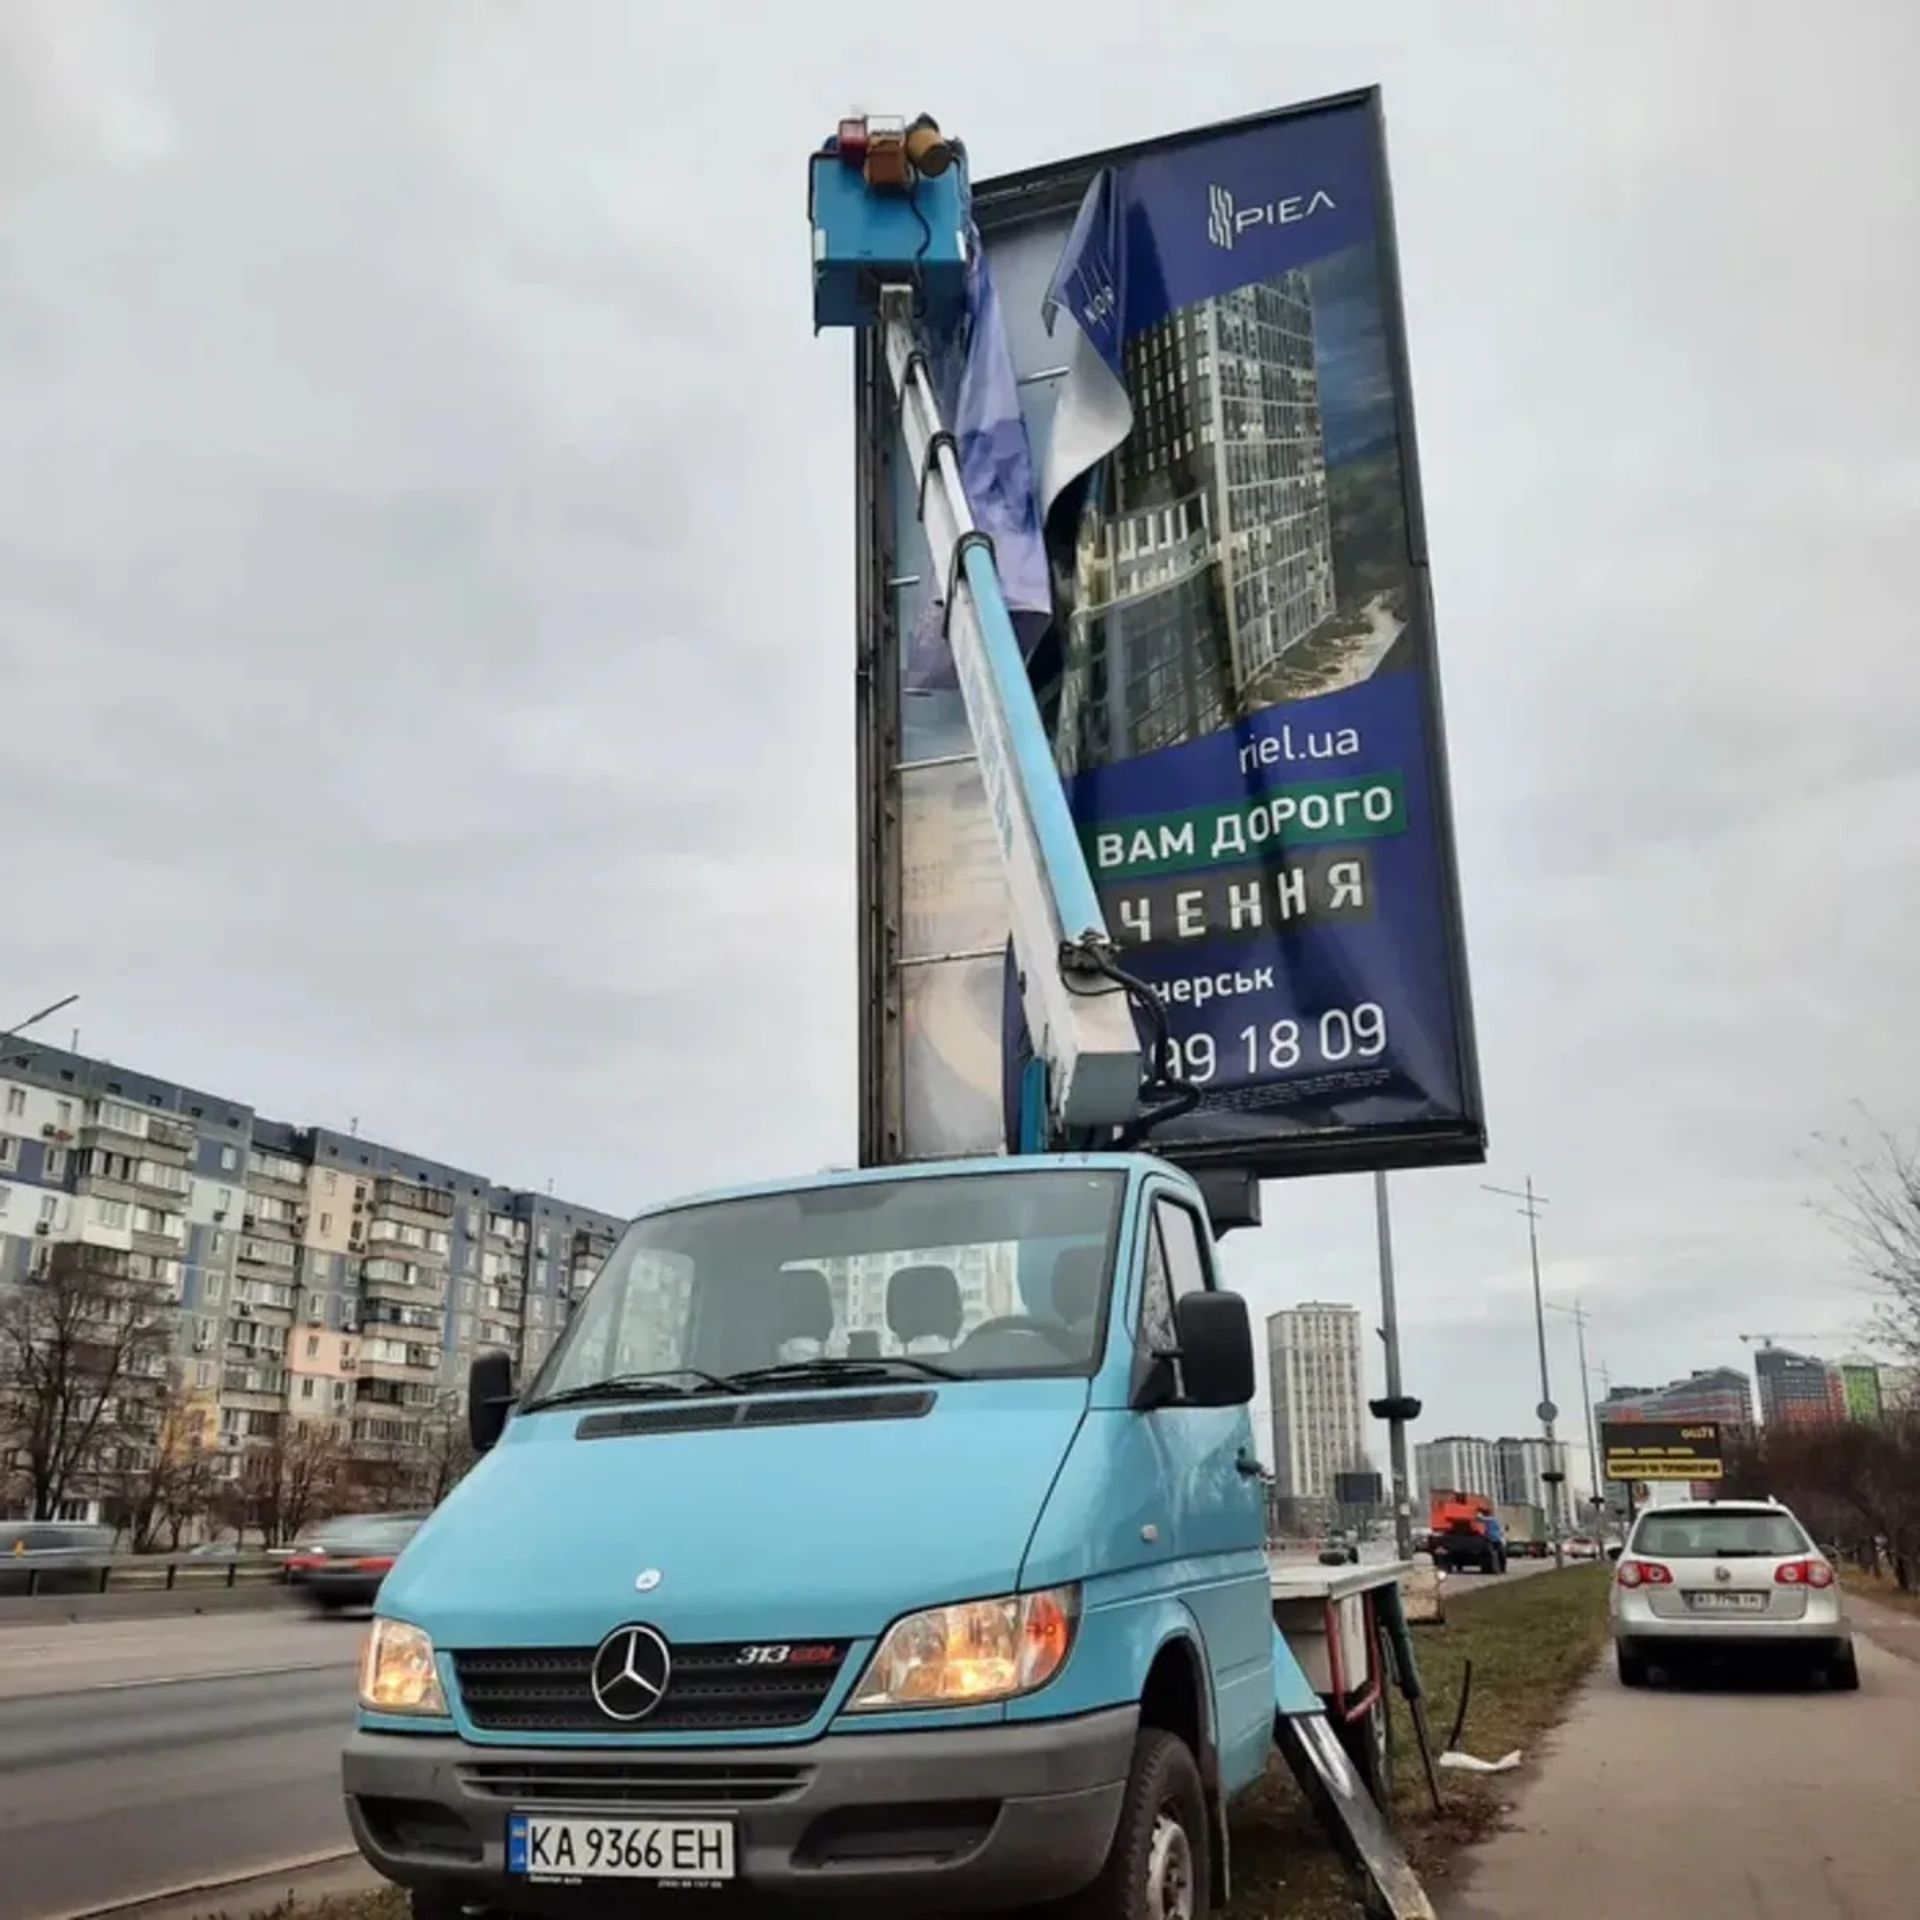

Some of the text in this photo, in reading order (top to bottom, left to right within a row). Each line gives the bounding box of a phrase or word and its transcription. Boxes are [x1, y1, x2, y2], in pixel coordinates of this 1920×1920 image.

[1238, 725, 1359, 773] riel.ua
[1097, 785, 1394, 868] ВАМ ДОРОГО
[1120, 861, 1365, 942] ЧЕННЯ
[1130, 966, 1275, 1008] черськ
[1239, 1019, 1301, 1075] 18
[1319, 1002, 1387, 1062] 09
[736, 1644, 791, 1665] 313
[530, 1825, 723, 1870] KA 9366 EH
